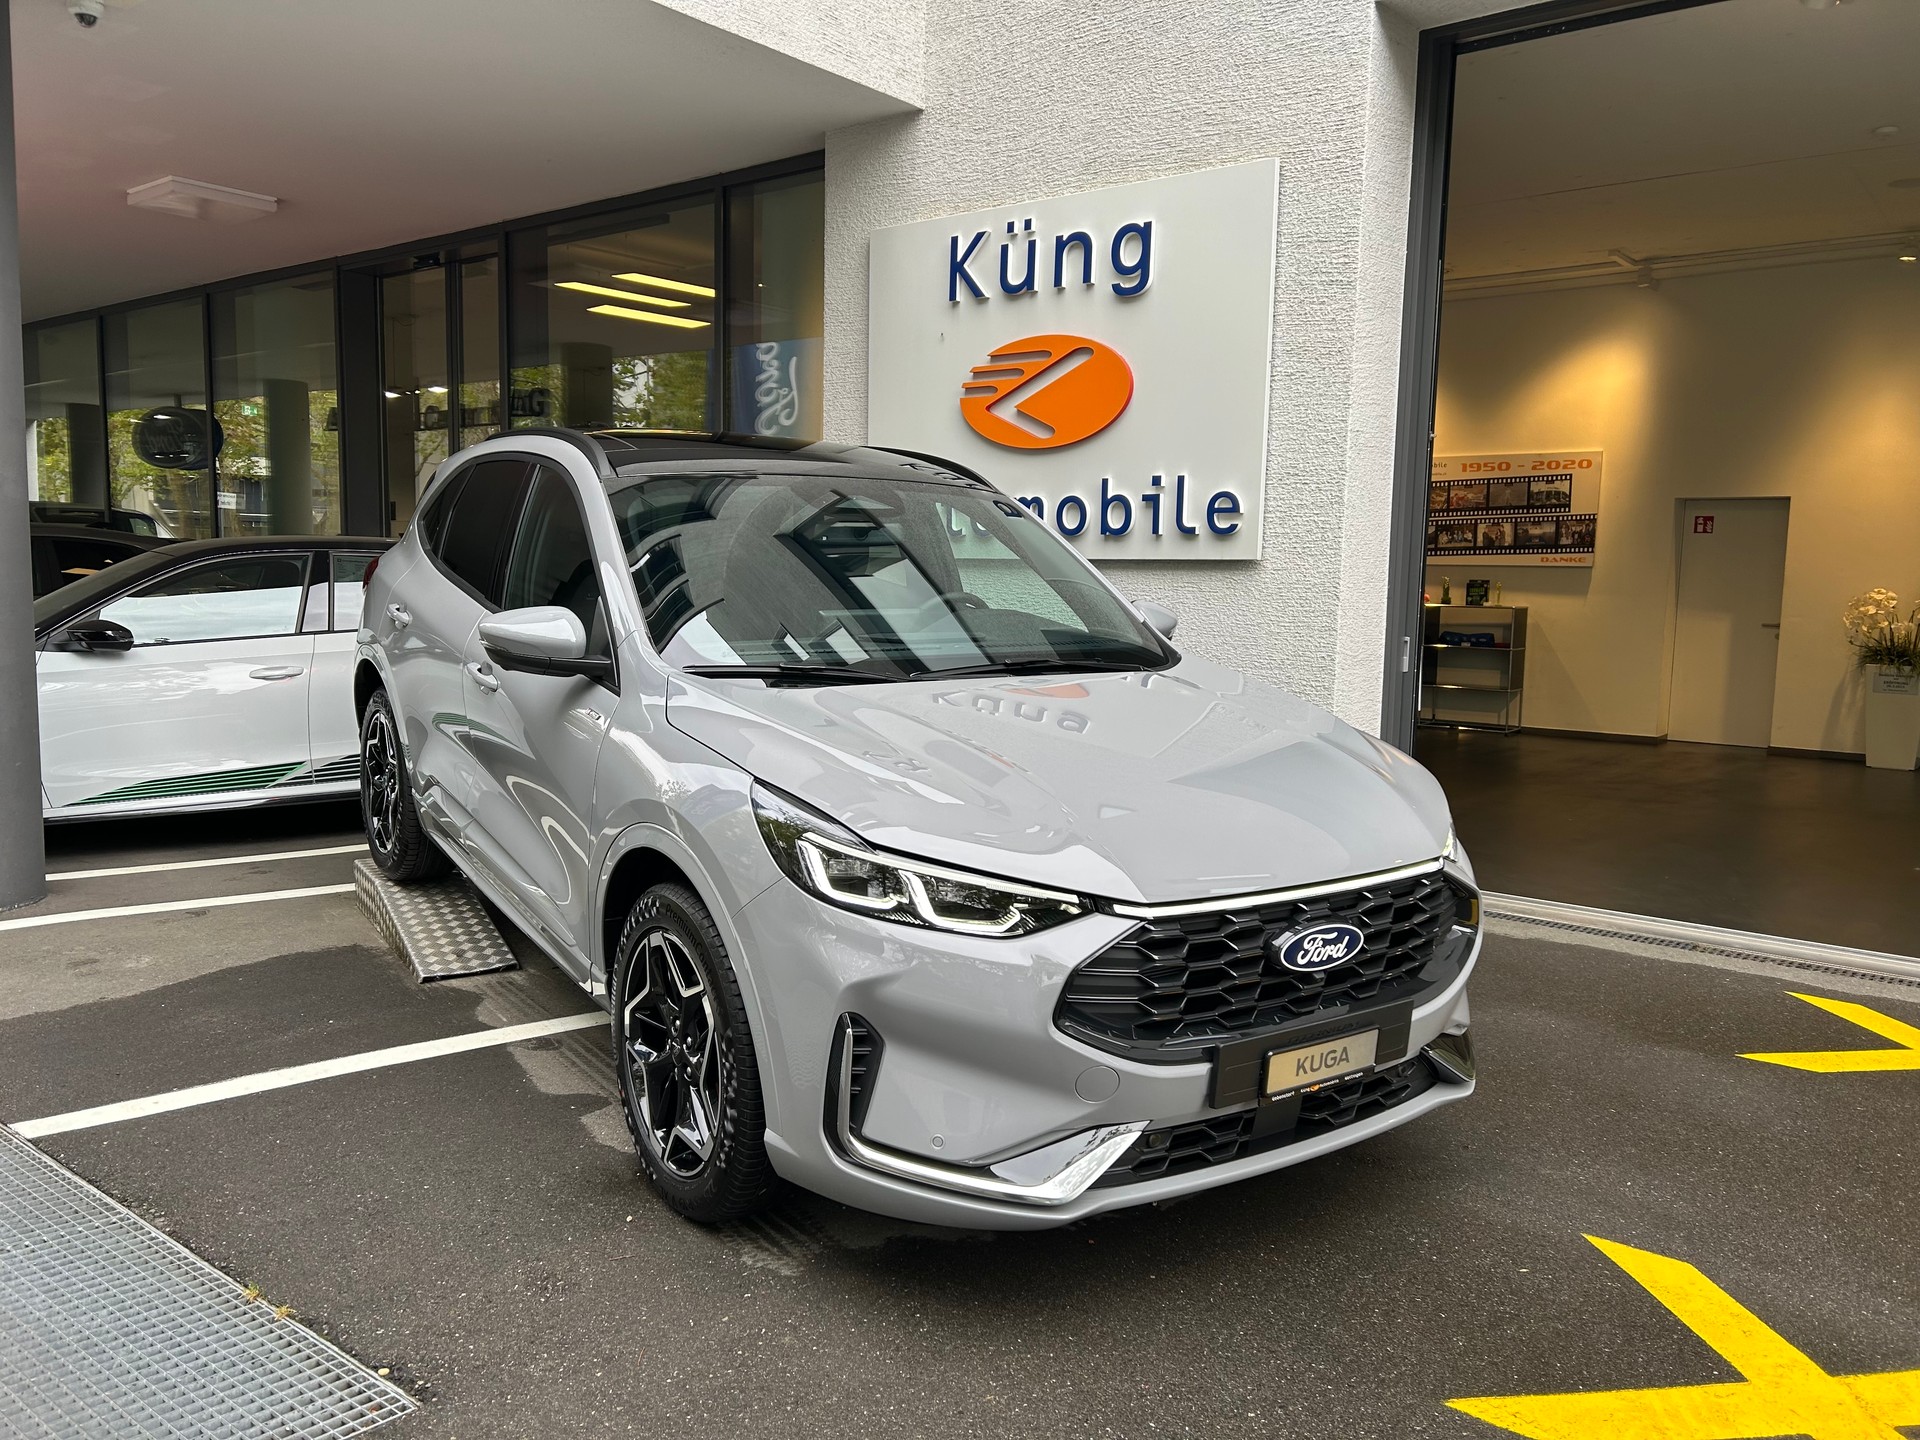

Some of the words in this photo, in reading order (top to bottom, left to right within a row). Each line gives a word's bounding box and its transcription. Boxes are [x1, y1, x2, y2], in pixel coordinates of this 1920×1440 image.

[948, 217, 1155, 302] Küng
[1461, 461, 1511, 473] 1950
[1531, 459, 1593, 471] 2020
[1297, 931, 1349, 965] Ford
[1295, 1046, 1350, 1077] KUGA
